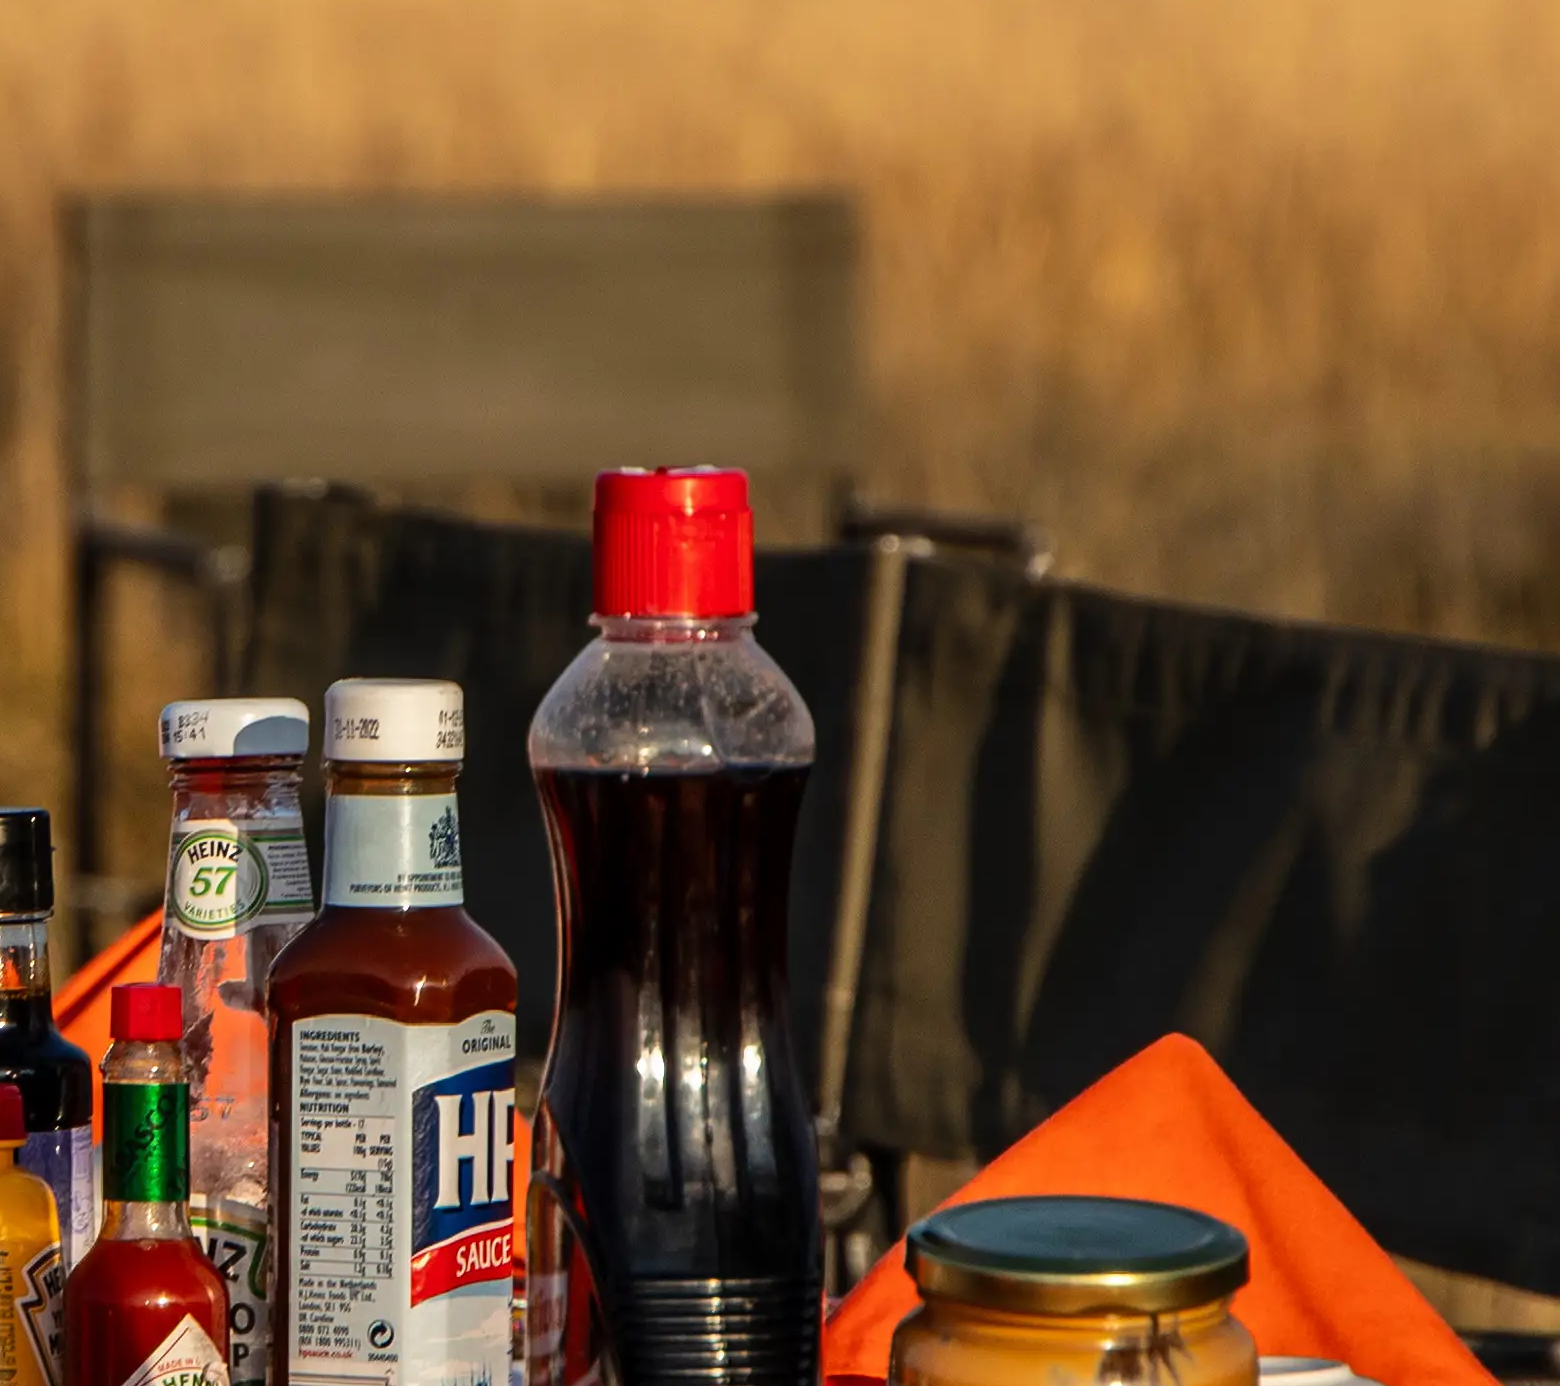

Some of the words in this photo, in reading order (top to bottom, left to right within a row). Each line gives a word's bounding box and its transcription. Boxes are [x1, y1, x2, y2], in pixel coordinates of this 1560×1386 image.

[187, 840, 243, 864] HEINZ
[189, 865, 237, 897] 57
[299, 1030, 360, 1043] INGREDIENTS
[462, 1034, 512, 1054] ORIGINAL
[299, 1102, 349, 1113] NUTRITION
[456, 1233, 512, 1277] SAUCE
